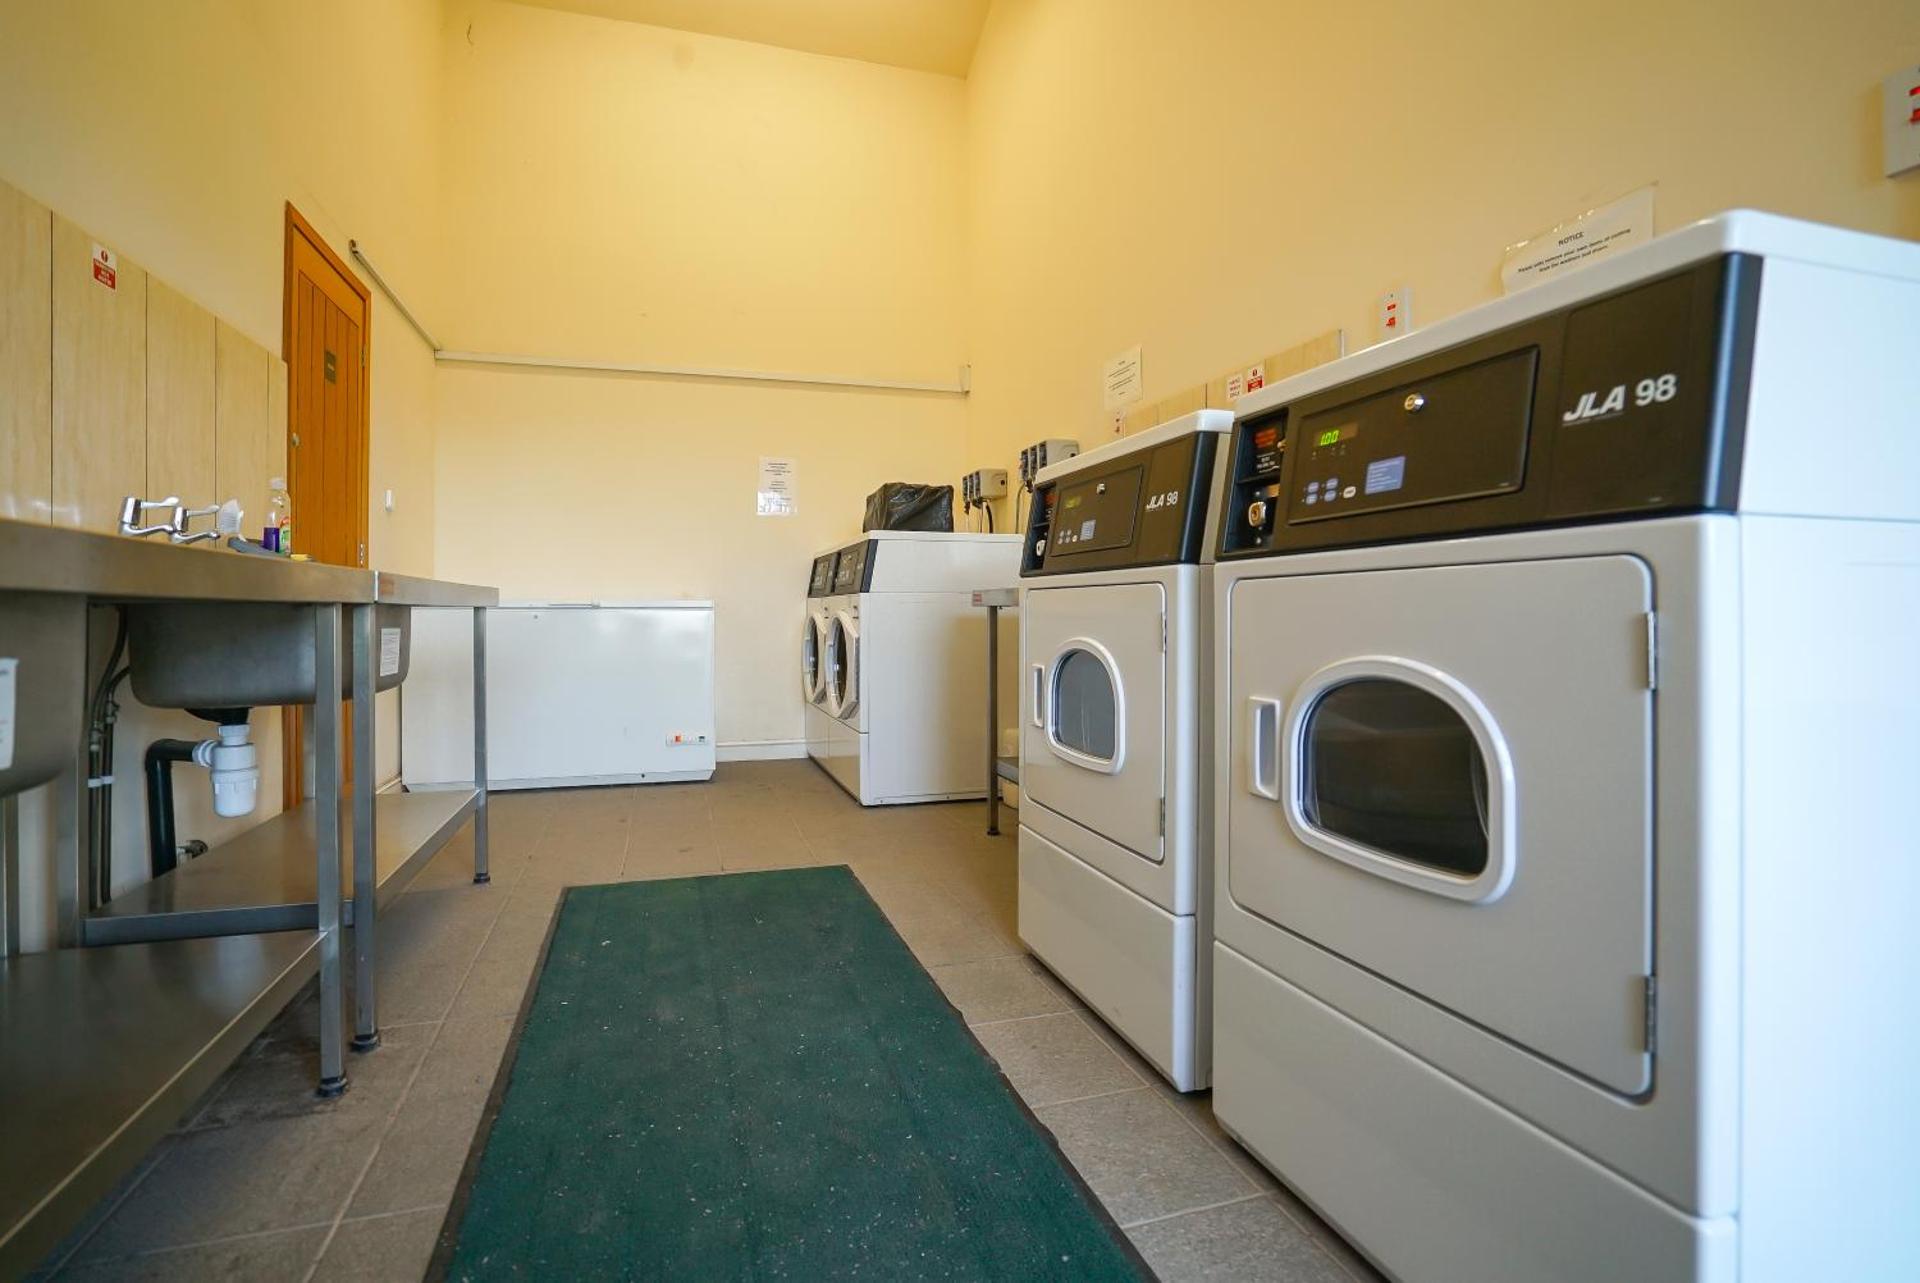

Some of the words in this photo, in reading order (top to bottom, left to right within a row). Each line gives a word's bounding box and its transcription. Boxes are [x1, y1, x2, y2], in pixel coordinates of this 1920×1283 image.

[1558, 231, 1584, 246] NOTICE
[1562, 385, 1626, 422] JLA
[1635, 373, 1678, 407] 98
[1146, 494, 1165, 509] JLA
[1166, 491, 1179, 506] 98
